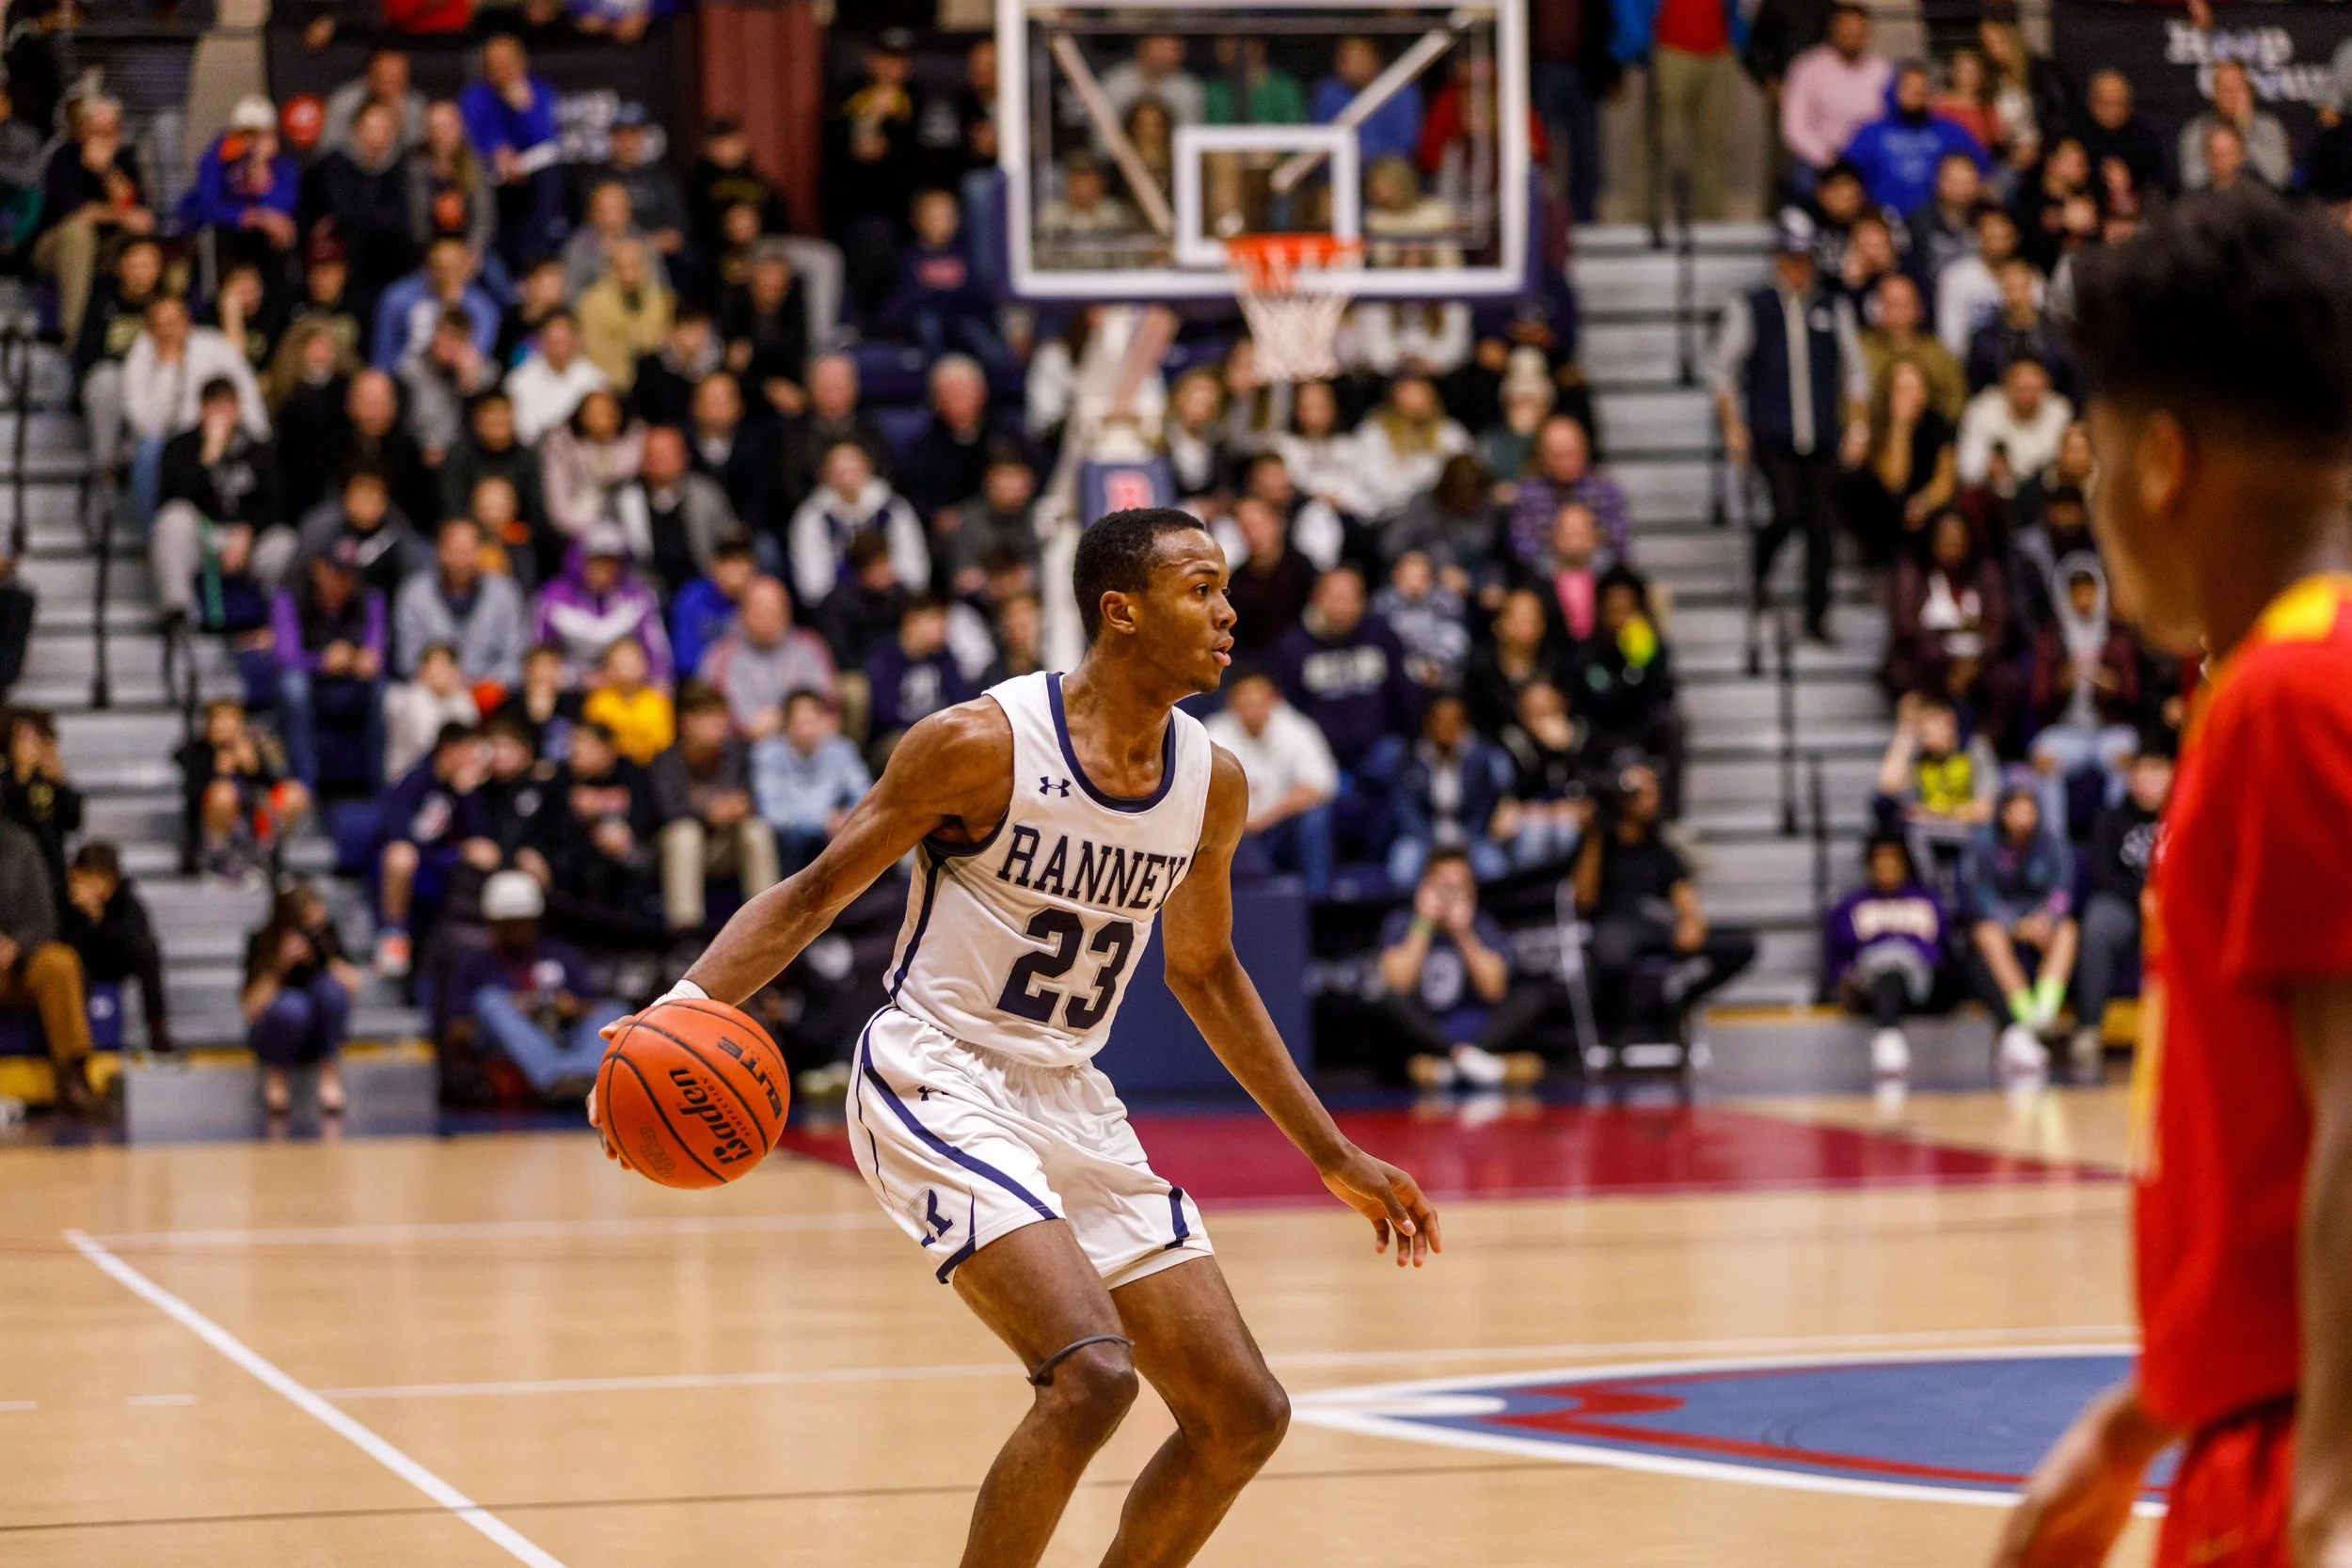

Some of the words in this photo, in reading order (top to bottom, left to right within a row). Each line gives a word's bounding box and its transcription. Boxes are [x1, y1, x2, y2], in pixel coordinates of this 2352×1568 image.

[996, 824, 1187, 910] RANNEY
[993, 905, 1136, 1030] 23
[669, 1069, 754, 1164] Baden
[717, 1036, 783, 1121] ELITE
